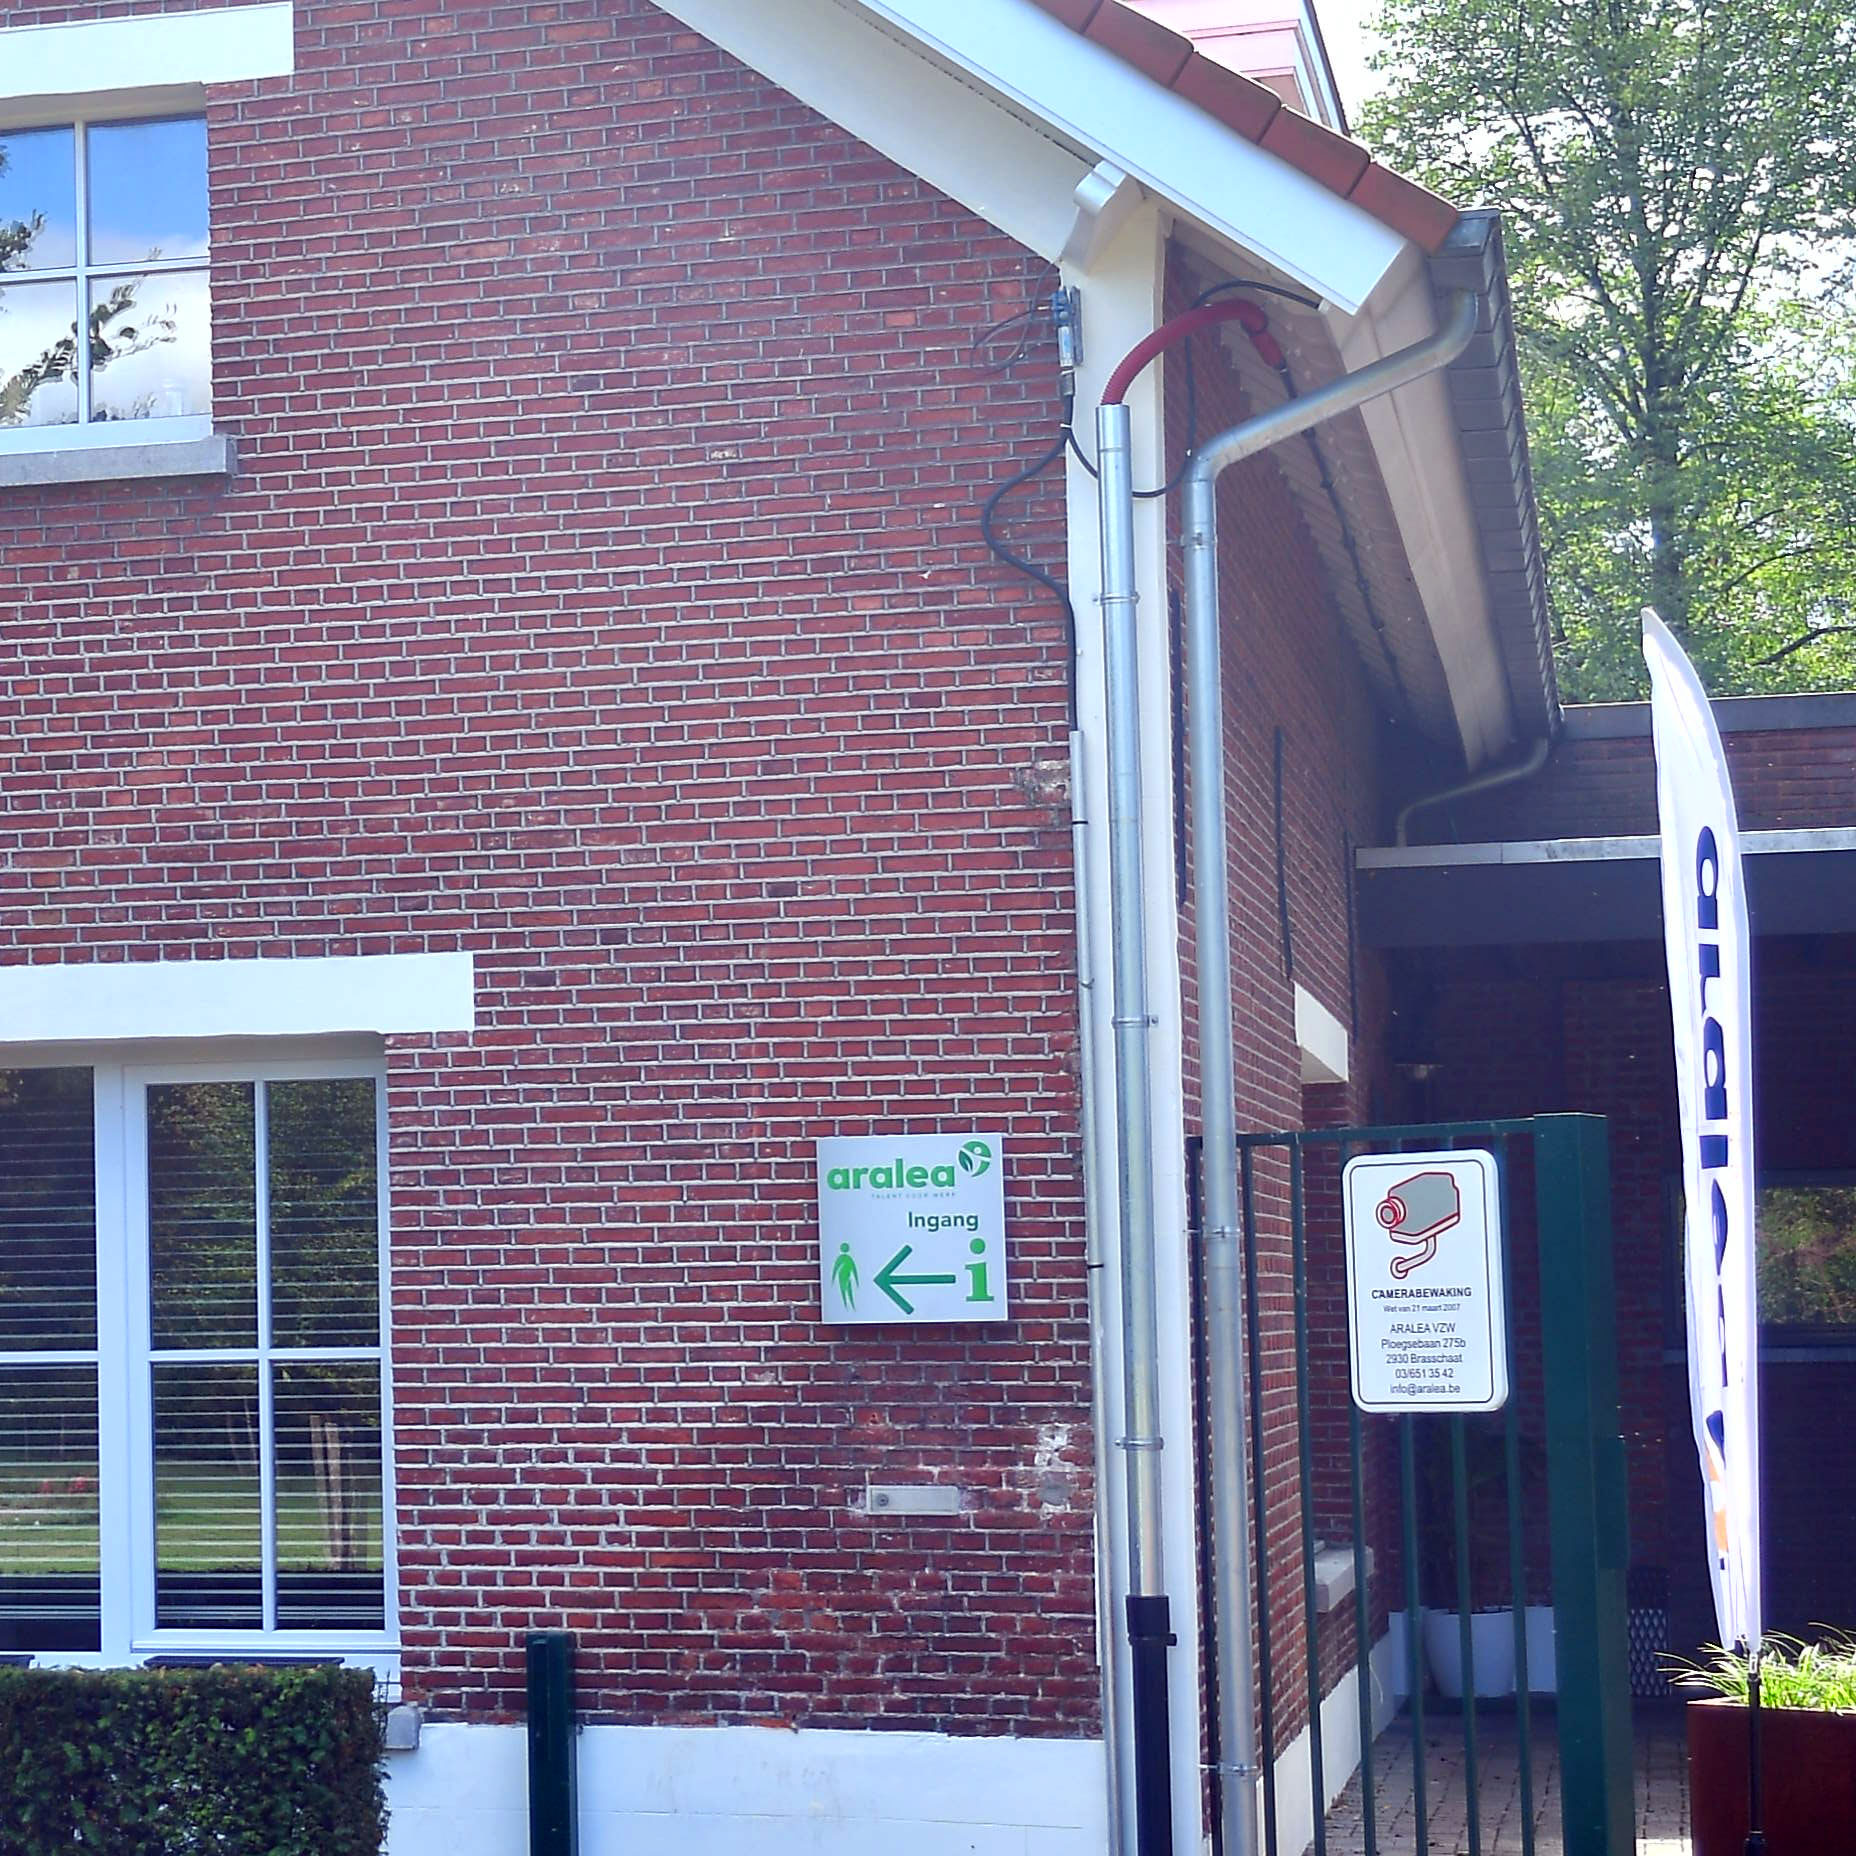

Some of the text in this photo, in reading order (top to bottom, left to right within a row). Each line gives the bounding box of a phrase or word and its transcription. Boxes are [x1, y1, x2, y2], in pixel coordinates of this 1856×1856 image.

[827, 1158, 955, 1190] aralea
[908, 1211, 979, 1232] Ingang
[1371, 1287, 1472, 1299] CAMERABEWAKING
[1390, 1322, 1456, 1334] ARALEA VZW
[1381, 1337, 1466, 1351] Ploegsebaan 275b
[1386, 1353, 1463, 1364] 2930 Brasschaat
[1395, 1368, 1454, 1379] 03/651 35 42
[1390, 1383, 1461, 1396] info@aralea.be
